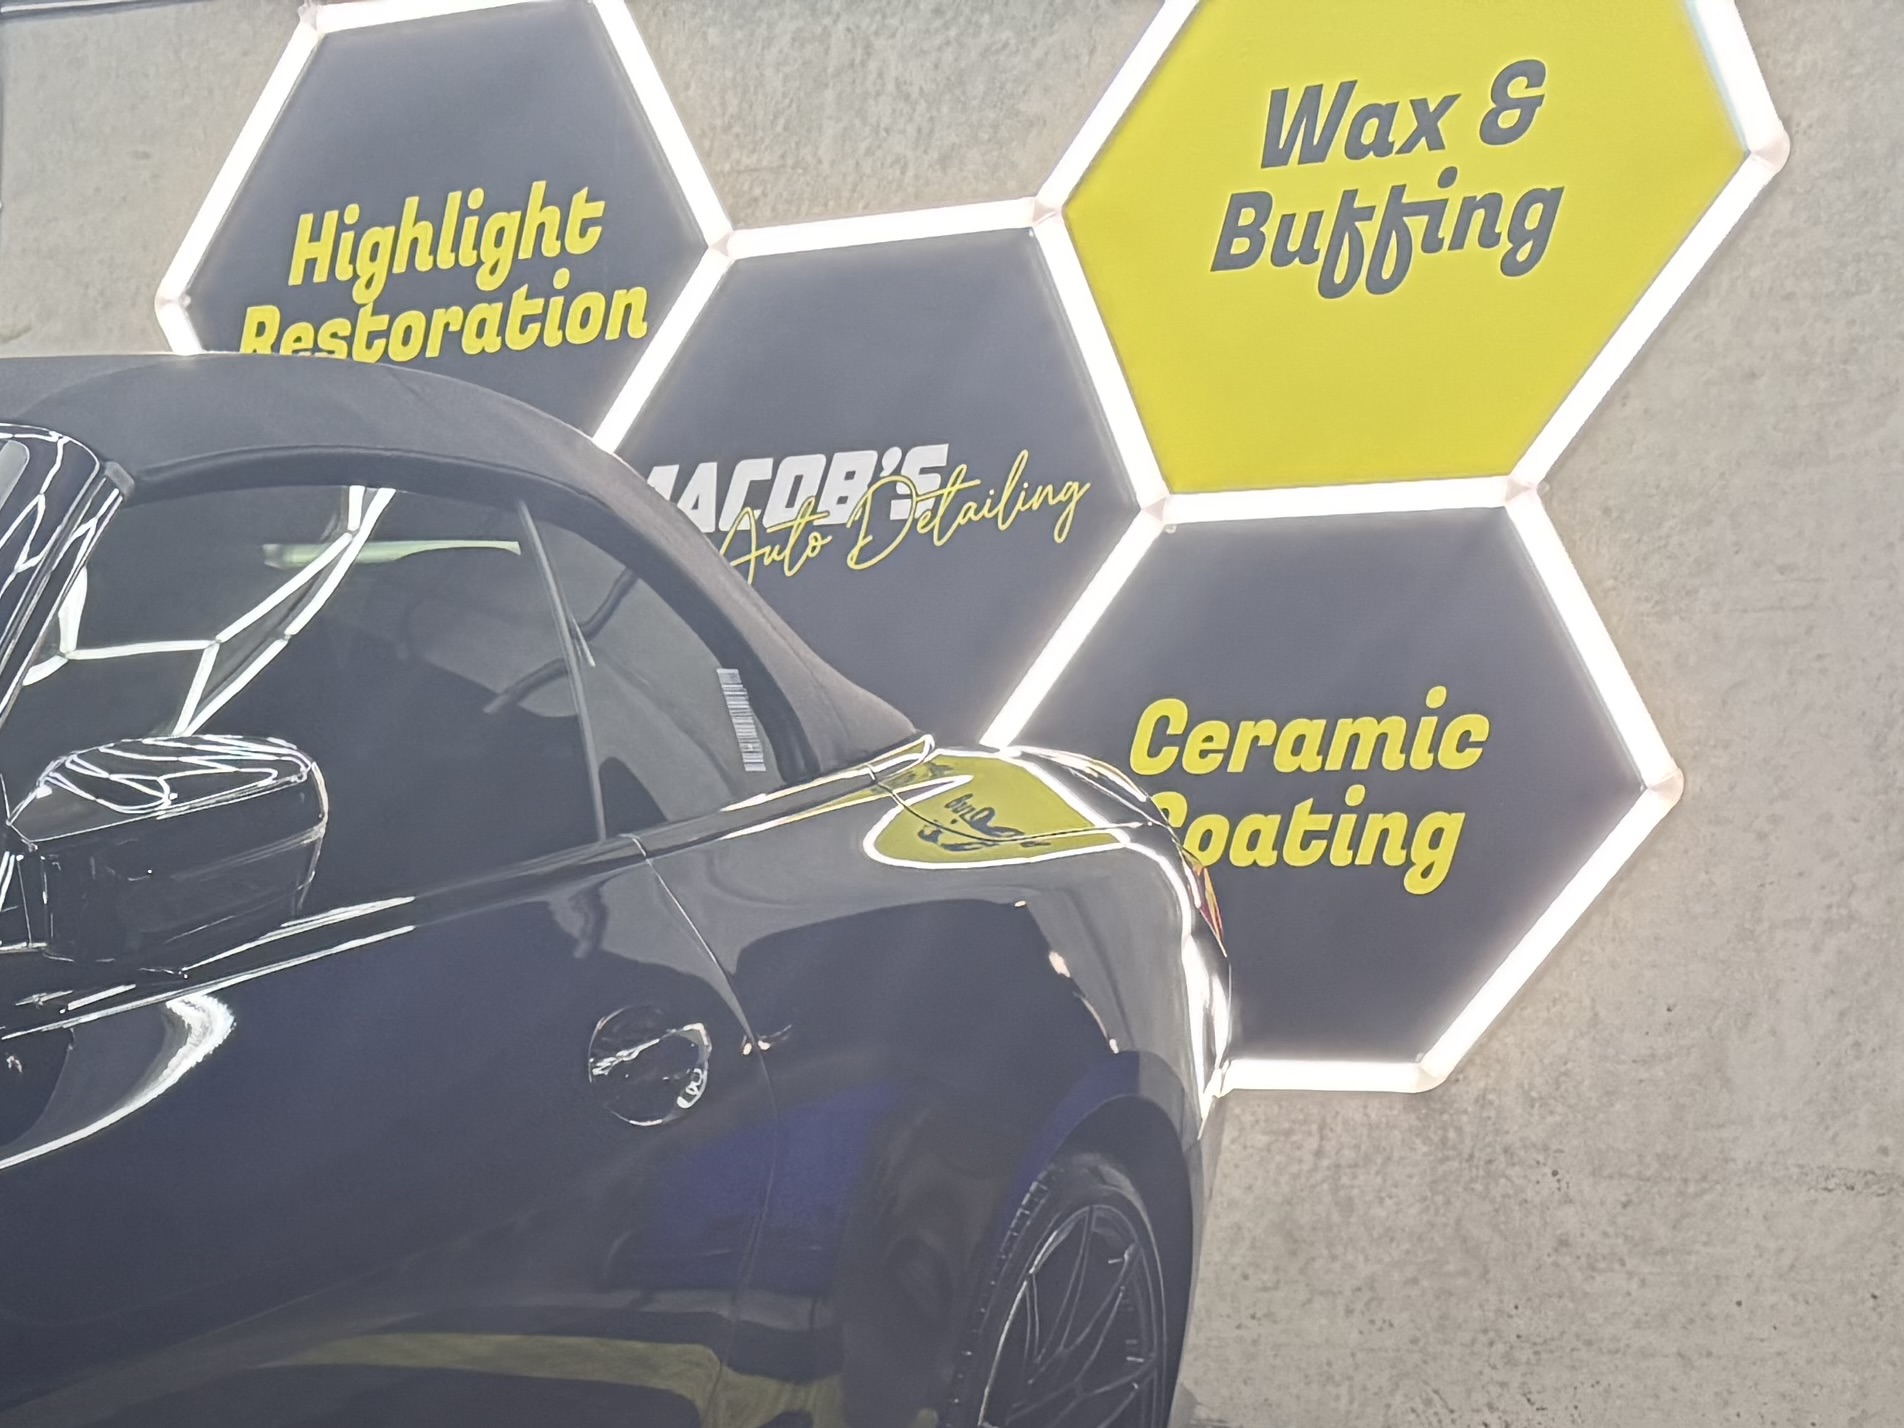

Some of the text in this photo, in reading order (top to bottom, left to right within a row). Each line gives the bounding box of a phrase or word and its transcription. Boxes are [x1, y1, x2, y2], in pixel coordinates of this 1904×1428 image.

[1261, 58, 1548, 169] Wax &
[287, 179, 606, 305] Highlight
[1209, 165, 1566, 300] Buffing
[239, 266, 649, 364] Restoration
[718, 449, 1092, 586] Auto Detailing
[1129, 685, 1491, 776] Ceramic
